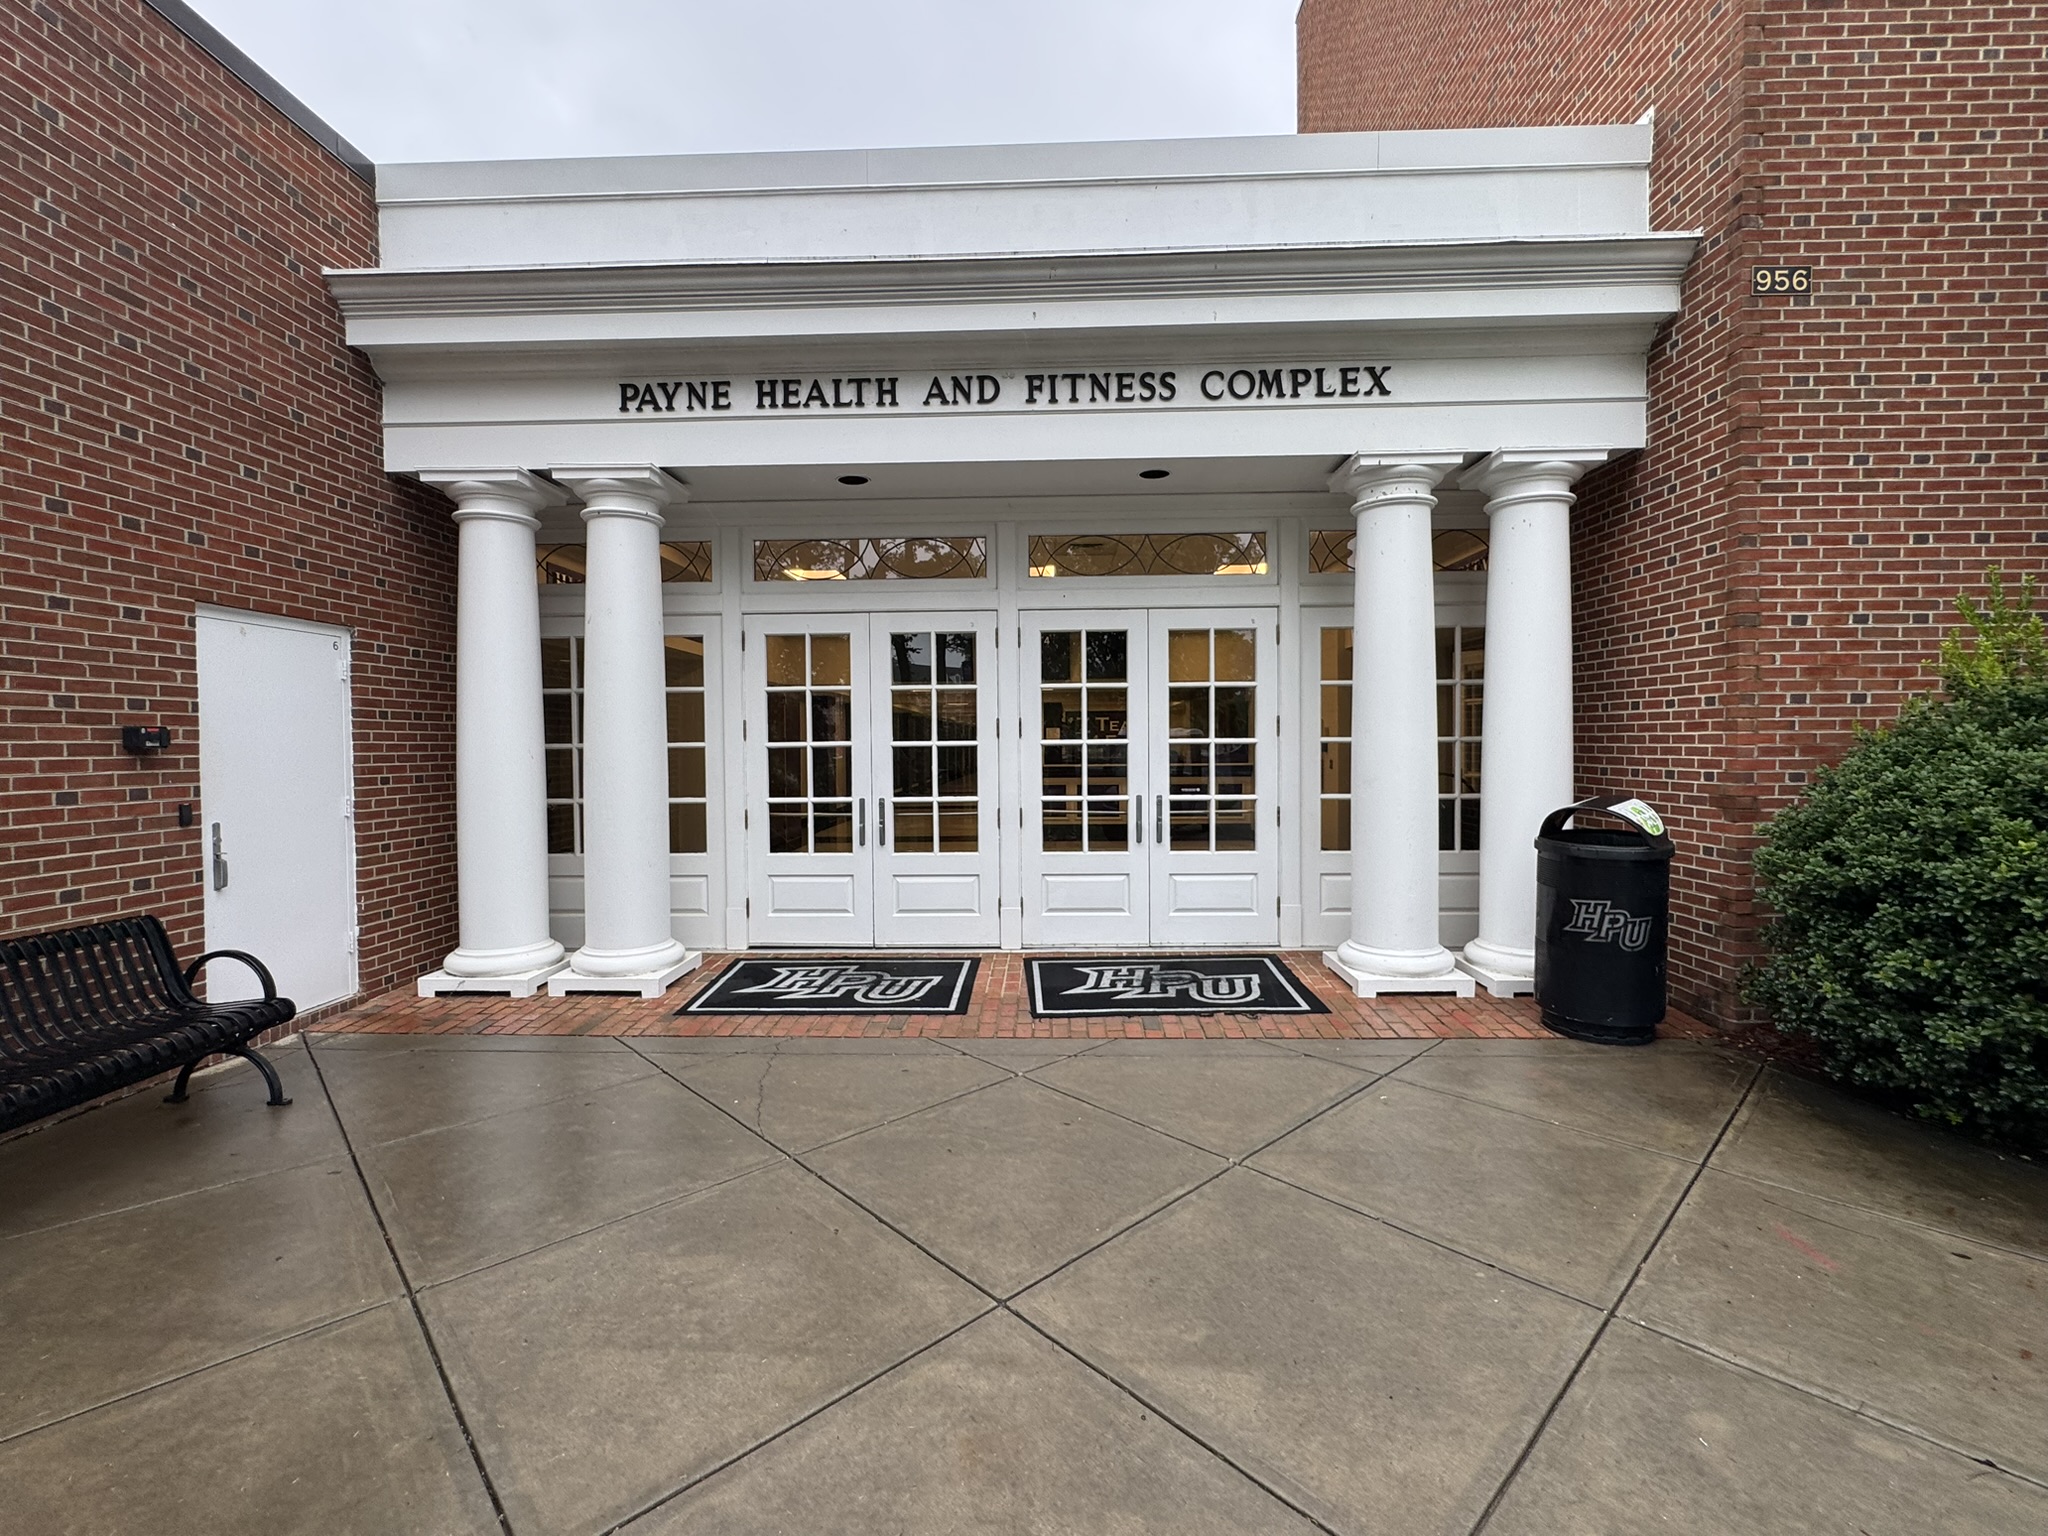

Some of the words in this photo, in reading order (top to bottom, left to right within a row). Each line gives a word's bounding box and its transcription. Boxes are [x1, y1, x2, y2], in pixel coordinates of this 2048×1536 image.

[1756, 269, 1808, 291] 956
[618, 381, 731, 412] PAYNE
[755, 377, 899, 409] HEALTH
[923, 375, 1000, 405] AND
[1024, 372, 1177, 404] FITNESS
[1200, 366, 1392, 400] COMPLEX
[332, 640, 339, 651] 6
[1563, 899, 1653, 952] HPU
[730, 965, 944, 1004] HPU
[1059, 965, 1262, 1004] HPU
